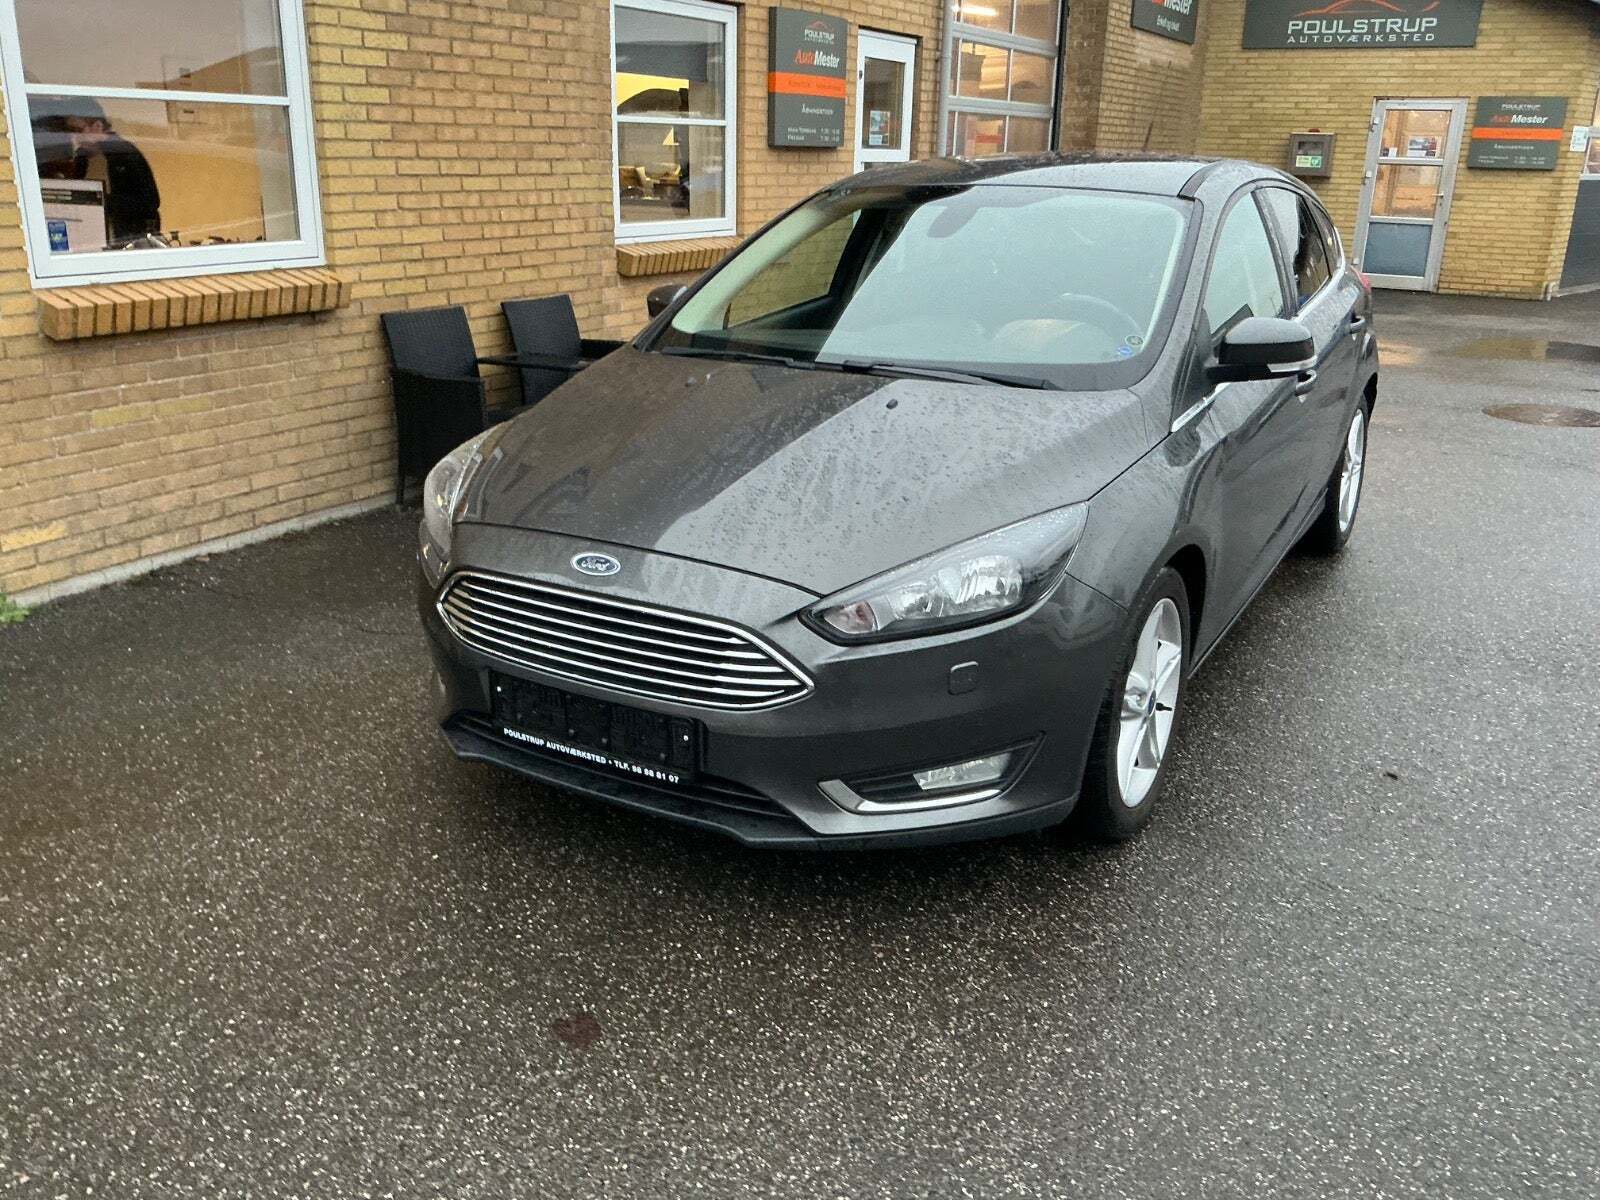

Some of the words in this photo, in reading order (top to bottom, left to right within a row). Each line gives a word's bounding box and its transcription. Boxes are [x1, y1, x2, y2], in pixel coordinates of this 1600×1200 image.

[1287, 17, 1438, 34] POULSTRUP
[1287, 34, 1435, 44] AUTOVÆRKSTED
[503, 727, 545, 747] POULSTRUP
[546, 741, 607, 765] AUTOVÆRKSTED
